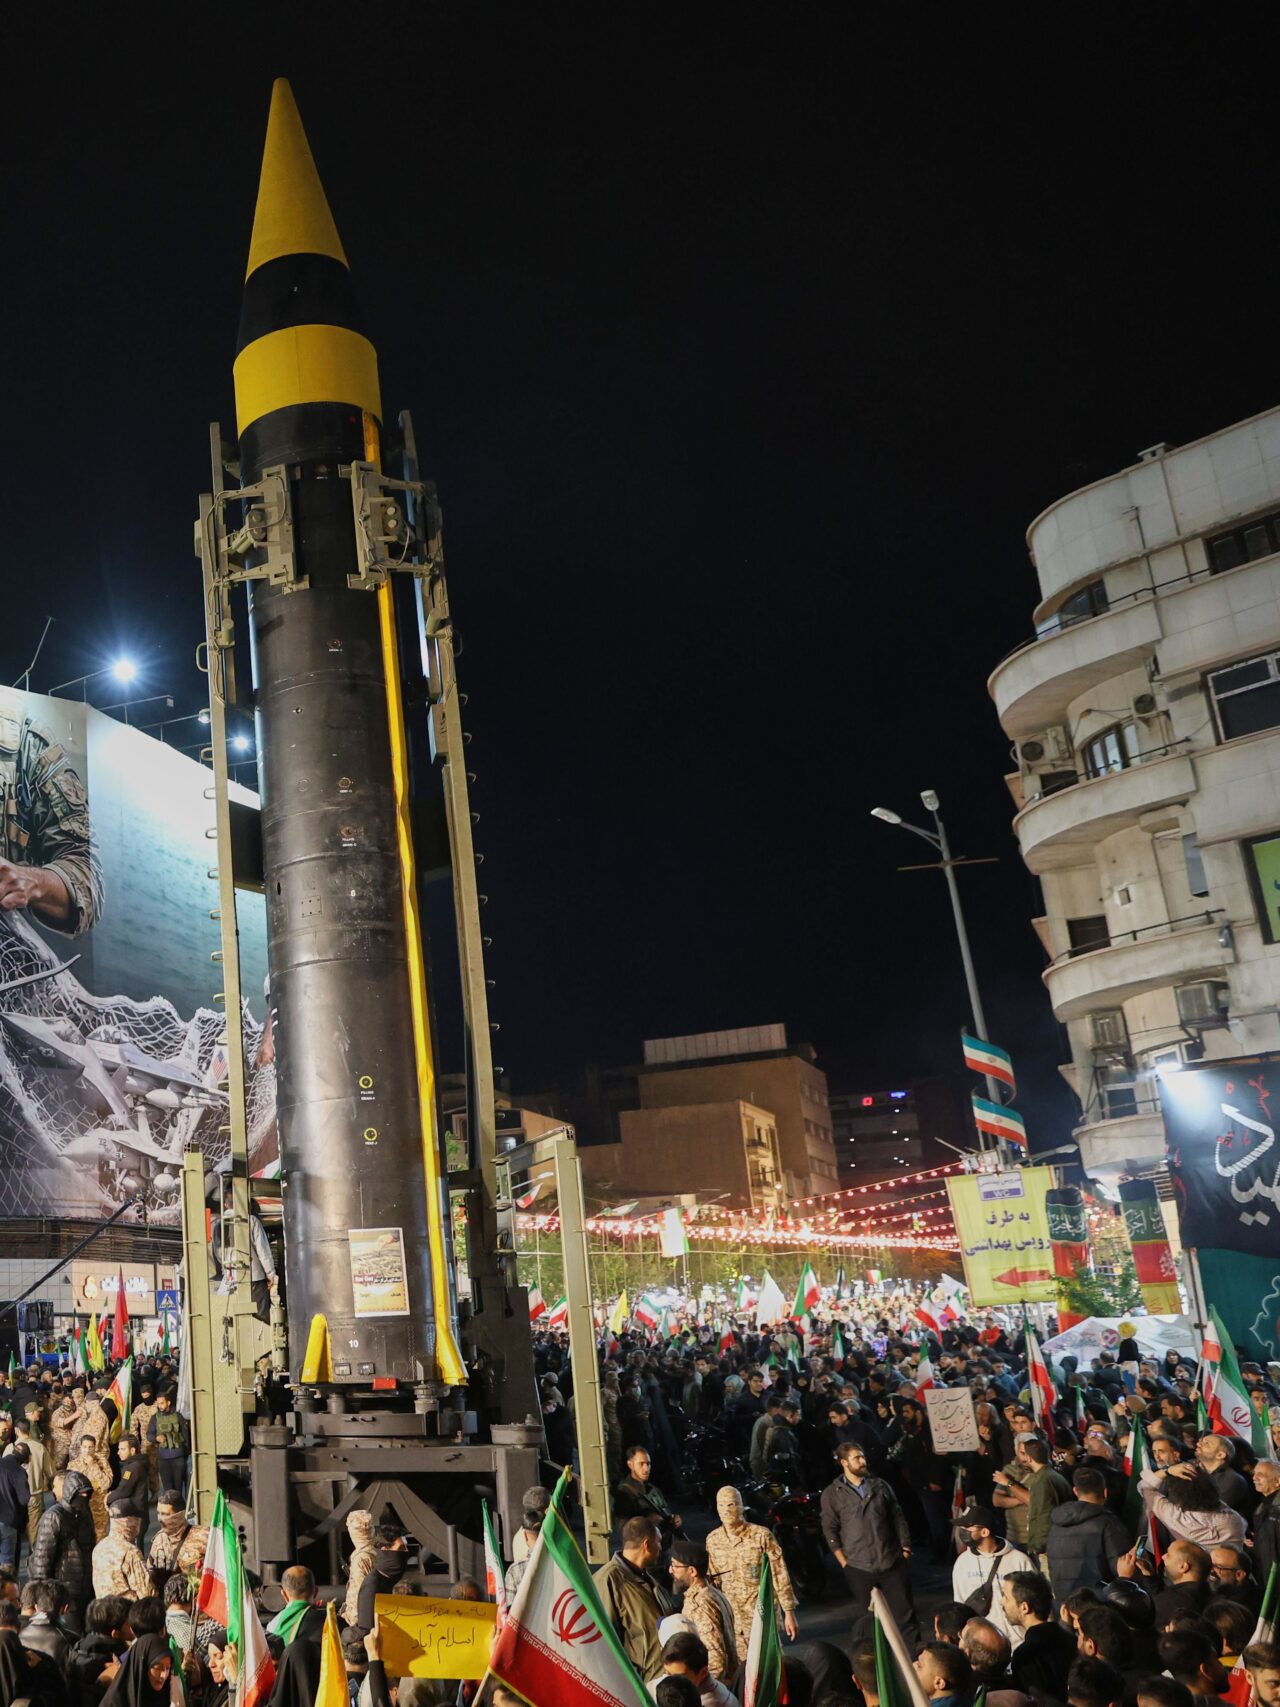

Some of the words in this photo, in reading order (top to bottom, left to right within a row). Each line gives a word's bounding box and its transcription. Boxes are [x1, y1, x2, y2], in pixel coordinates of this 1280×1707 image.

[985, 1209, 1014, 1228] طرف
[1019, 1211, 1030, 1225] به
[348, 1339, 359, 1348] 10
[411, 1622, 438, 1649] آباد
[436, 1626, 475, 1665] اسلام
